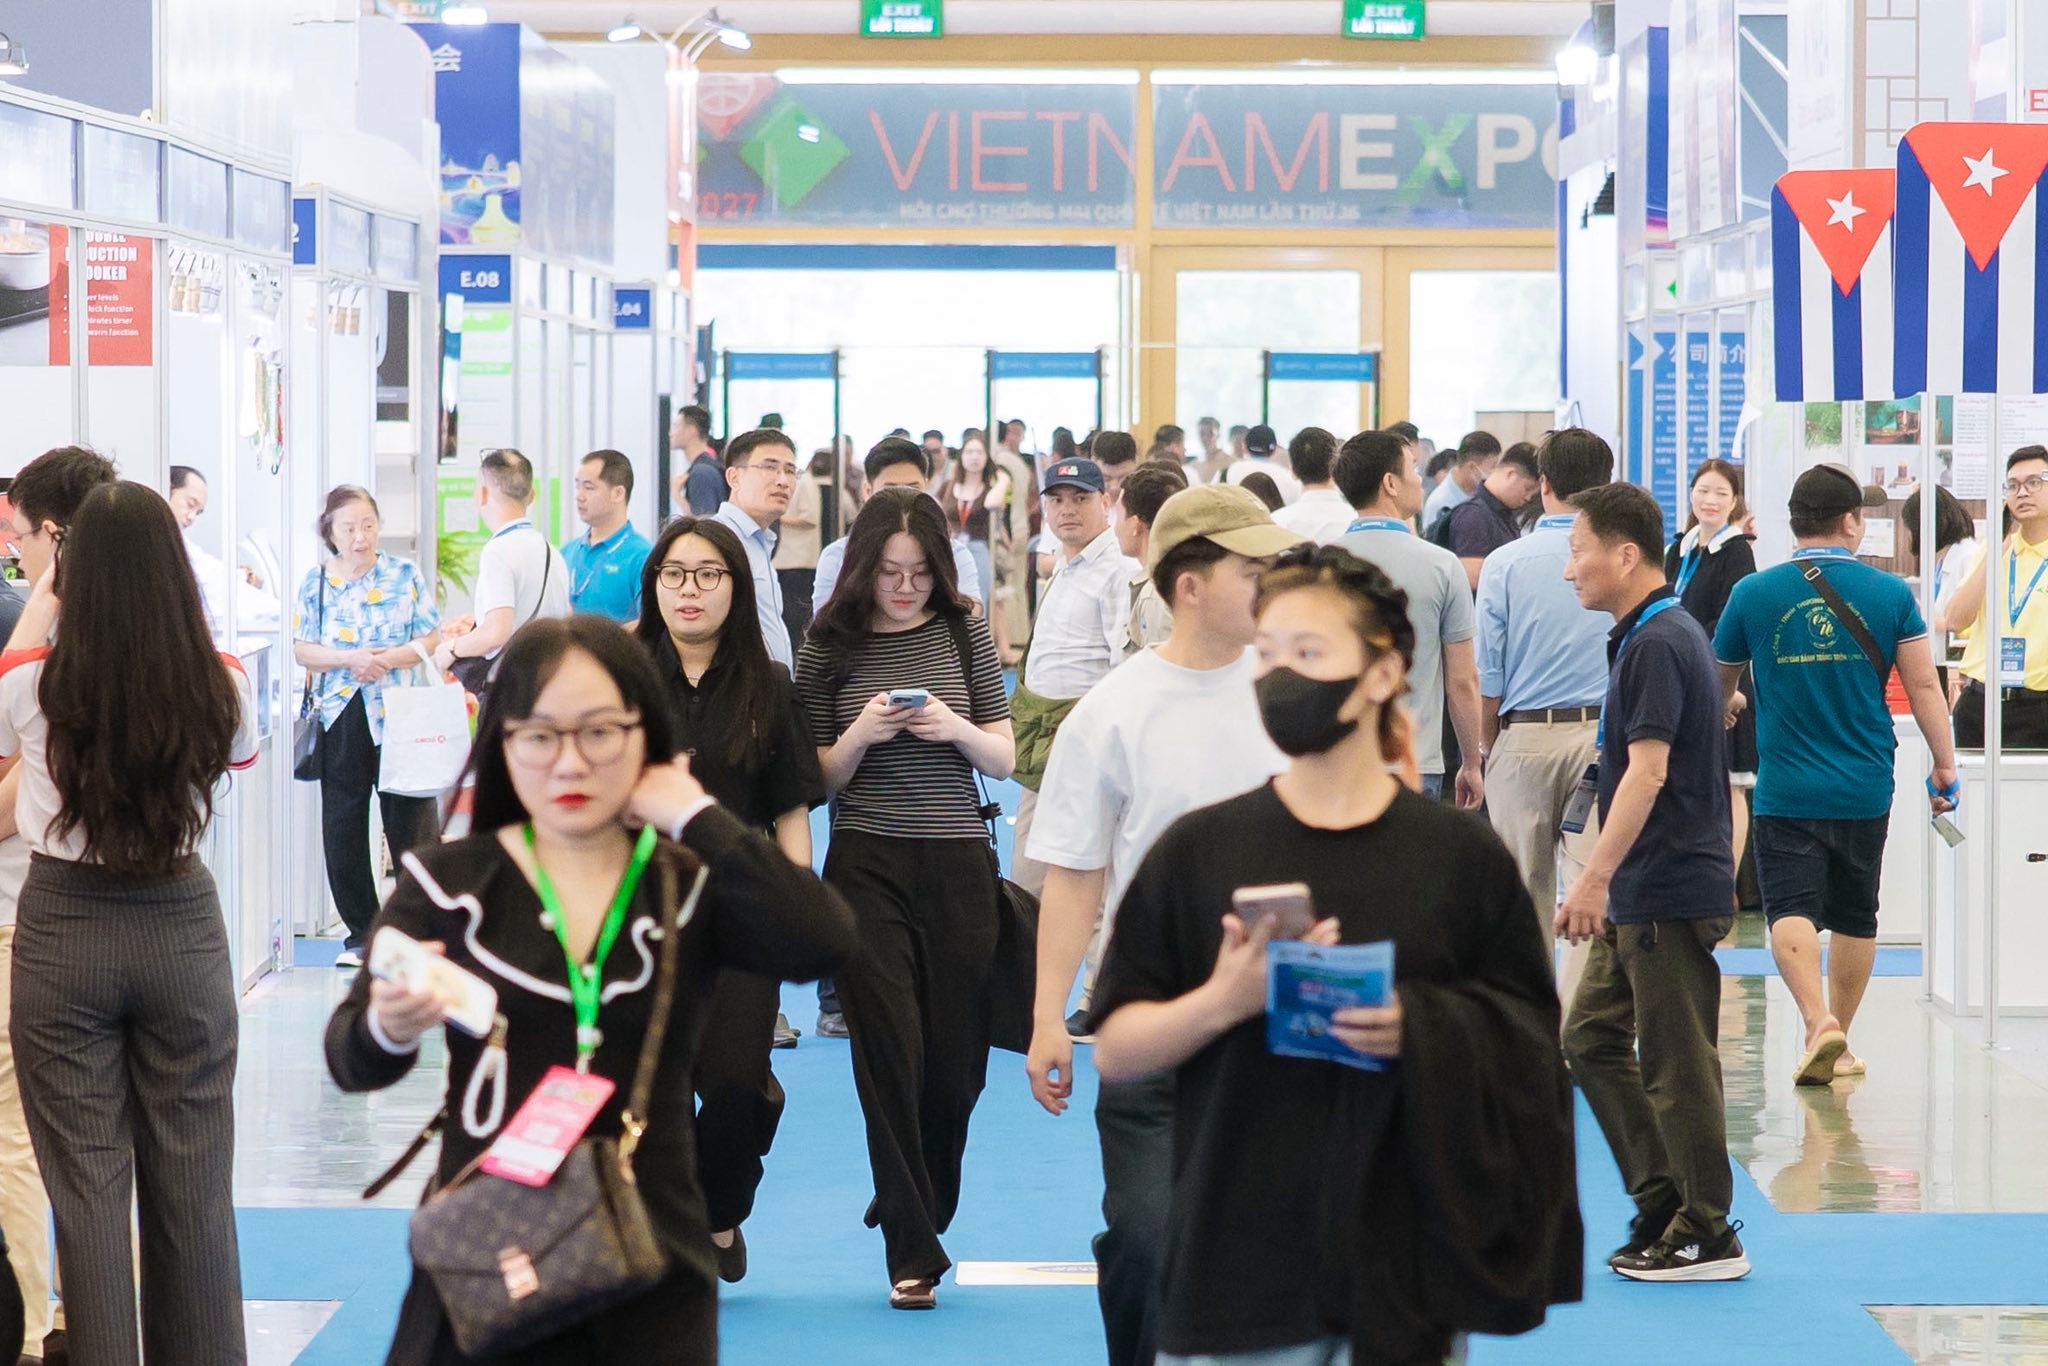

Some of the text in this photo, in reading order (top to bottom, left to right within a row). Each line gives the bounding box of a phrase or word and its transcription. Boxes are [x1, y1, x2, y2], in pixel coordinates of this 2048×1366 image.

[1364, 4, 1406, 17] EXIT
[65, 247, 137, 261] IUCTION
[86, 266, 127, 280] OOKER
[460, 270, 500, 288] E.08
